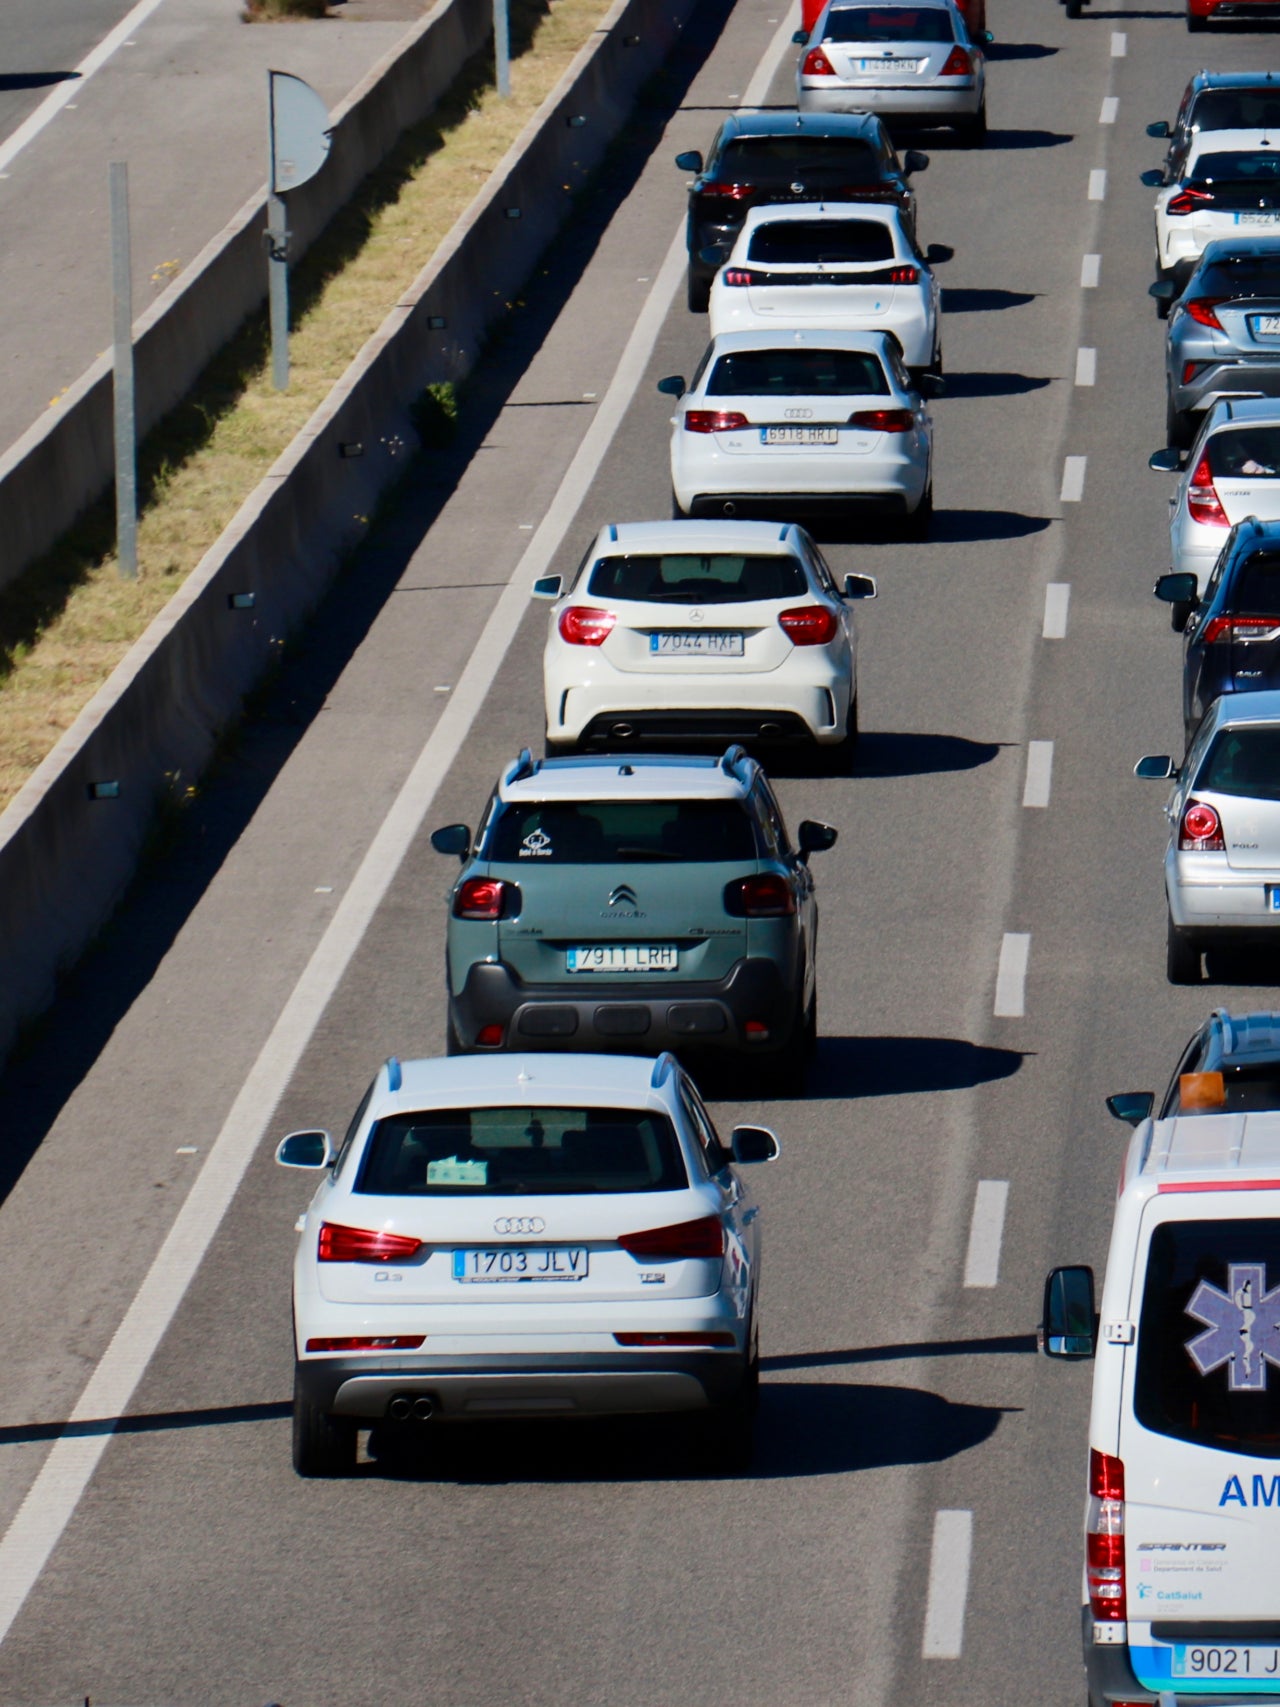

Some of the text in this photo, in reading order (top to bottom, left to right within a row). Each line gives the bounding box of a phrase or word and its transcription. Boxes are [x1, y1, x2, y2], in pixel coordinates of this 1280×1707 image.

[769, 428, 834, 440] 6918 HRT
[661, 634, 738, 649] 7044 HXF
[582, 947, 672, 965] 7911 LRH
[472, 1250, 580, 1272] 1703 JLV
[1136, 1543, 1227, 1551] SPRINTER
[1157, 1591, 1203, 1600] CatSalut
[1190, 1648, 1251, 1673] 9021
